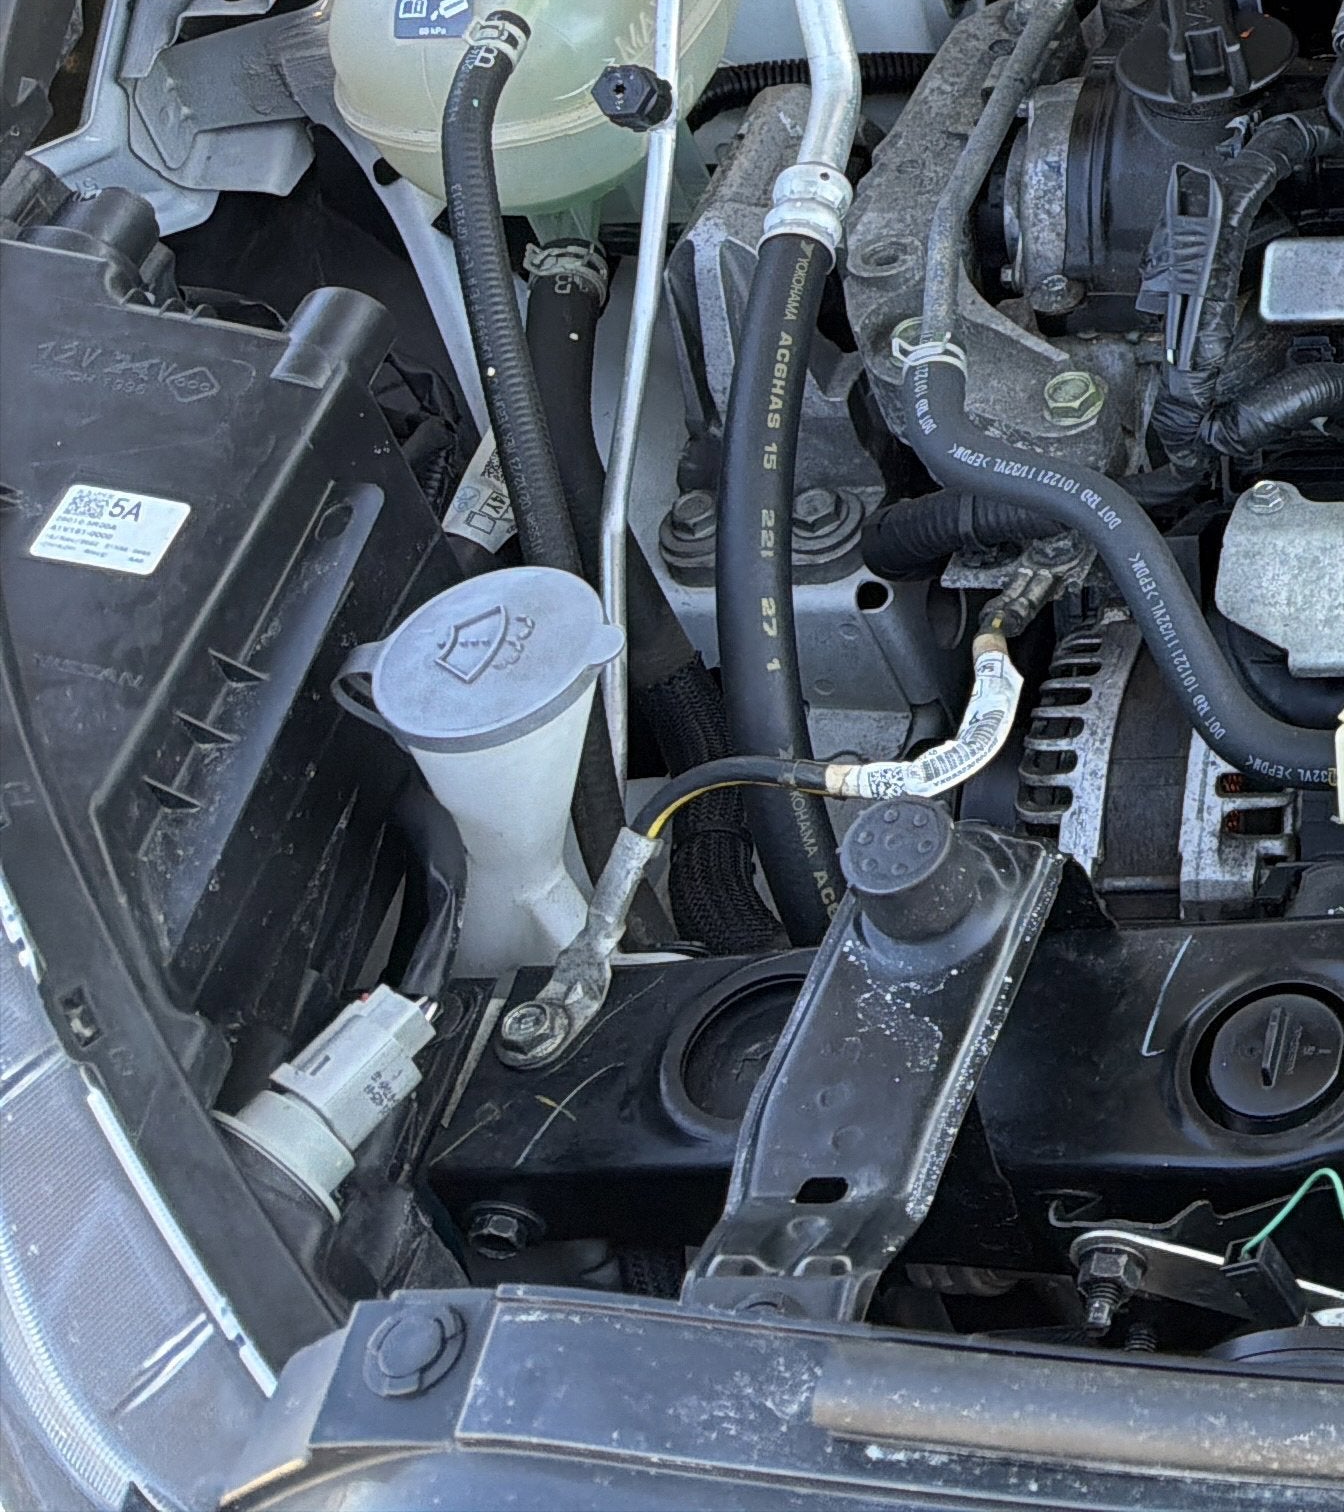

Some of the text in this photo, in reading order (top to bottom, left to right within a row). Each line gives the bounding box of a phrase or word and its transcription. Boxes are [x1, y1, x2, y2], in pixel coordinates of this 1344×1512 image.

[784, 257, 811, 321] YOKOHAMA
[763, 443, 778, 470] 15
[108, 497, 142, 522] 5A
[1097, 505, 1122, 530] DOT
[760, 509, 775, 558] 221
[761, 597, 778, 637] 27
[1169, 649, 1200, 693] 101221
[1204, 716, 1227, 740] DOT
